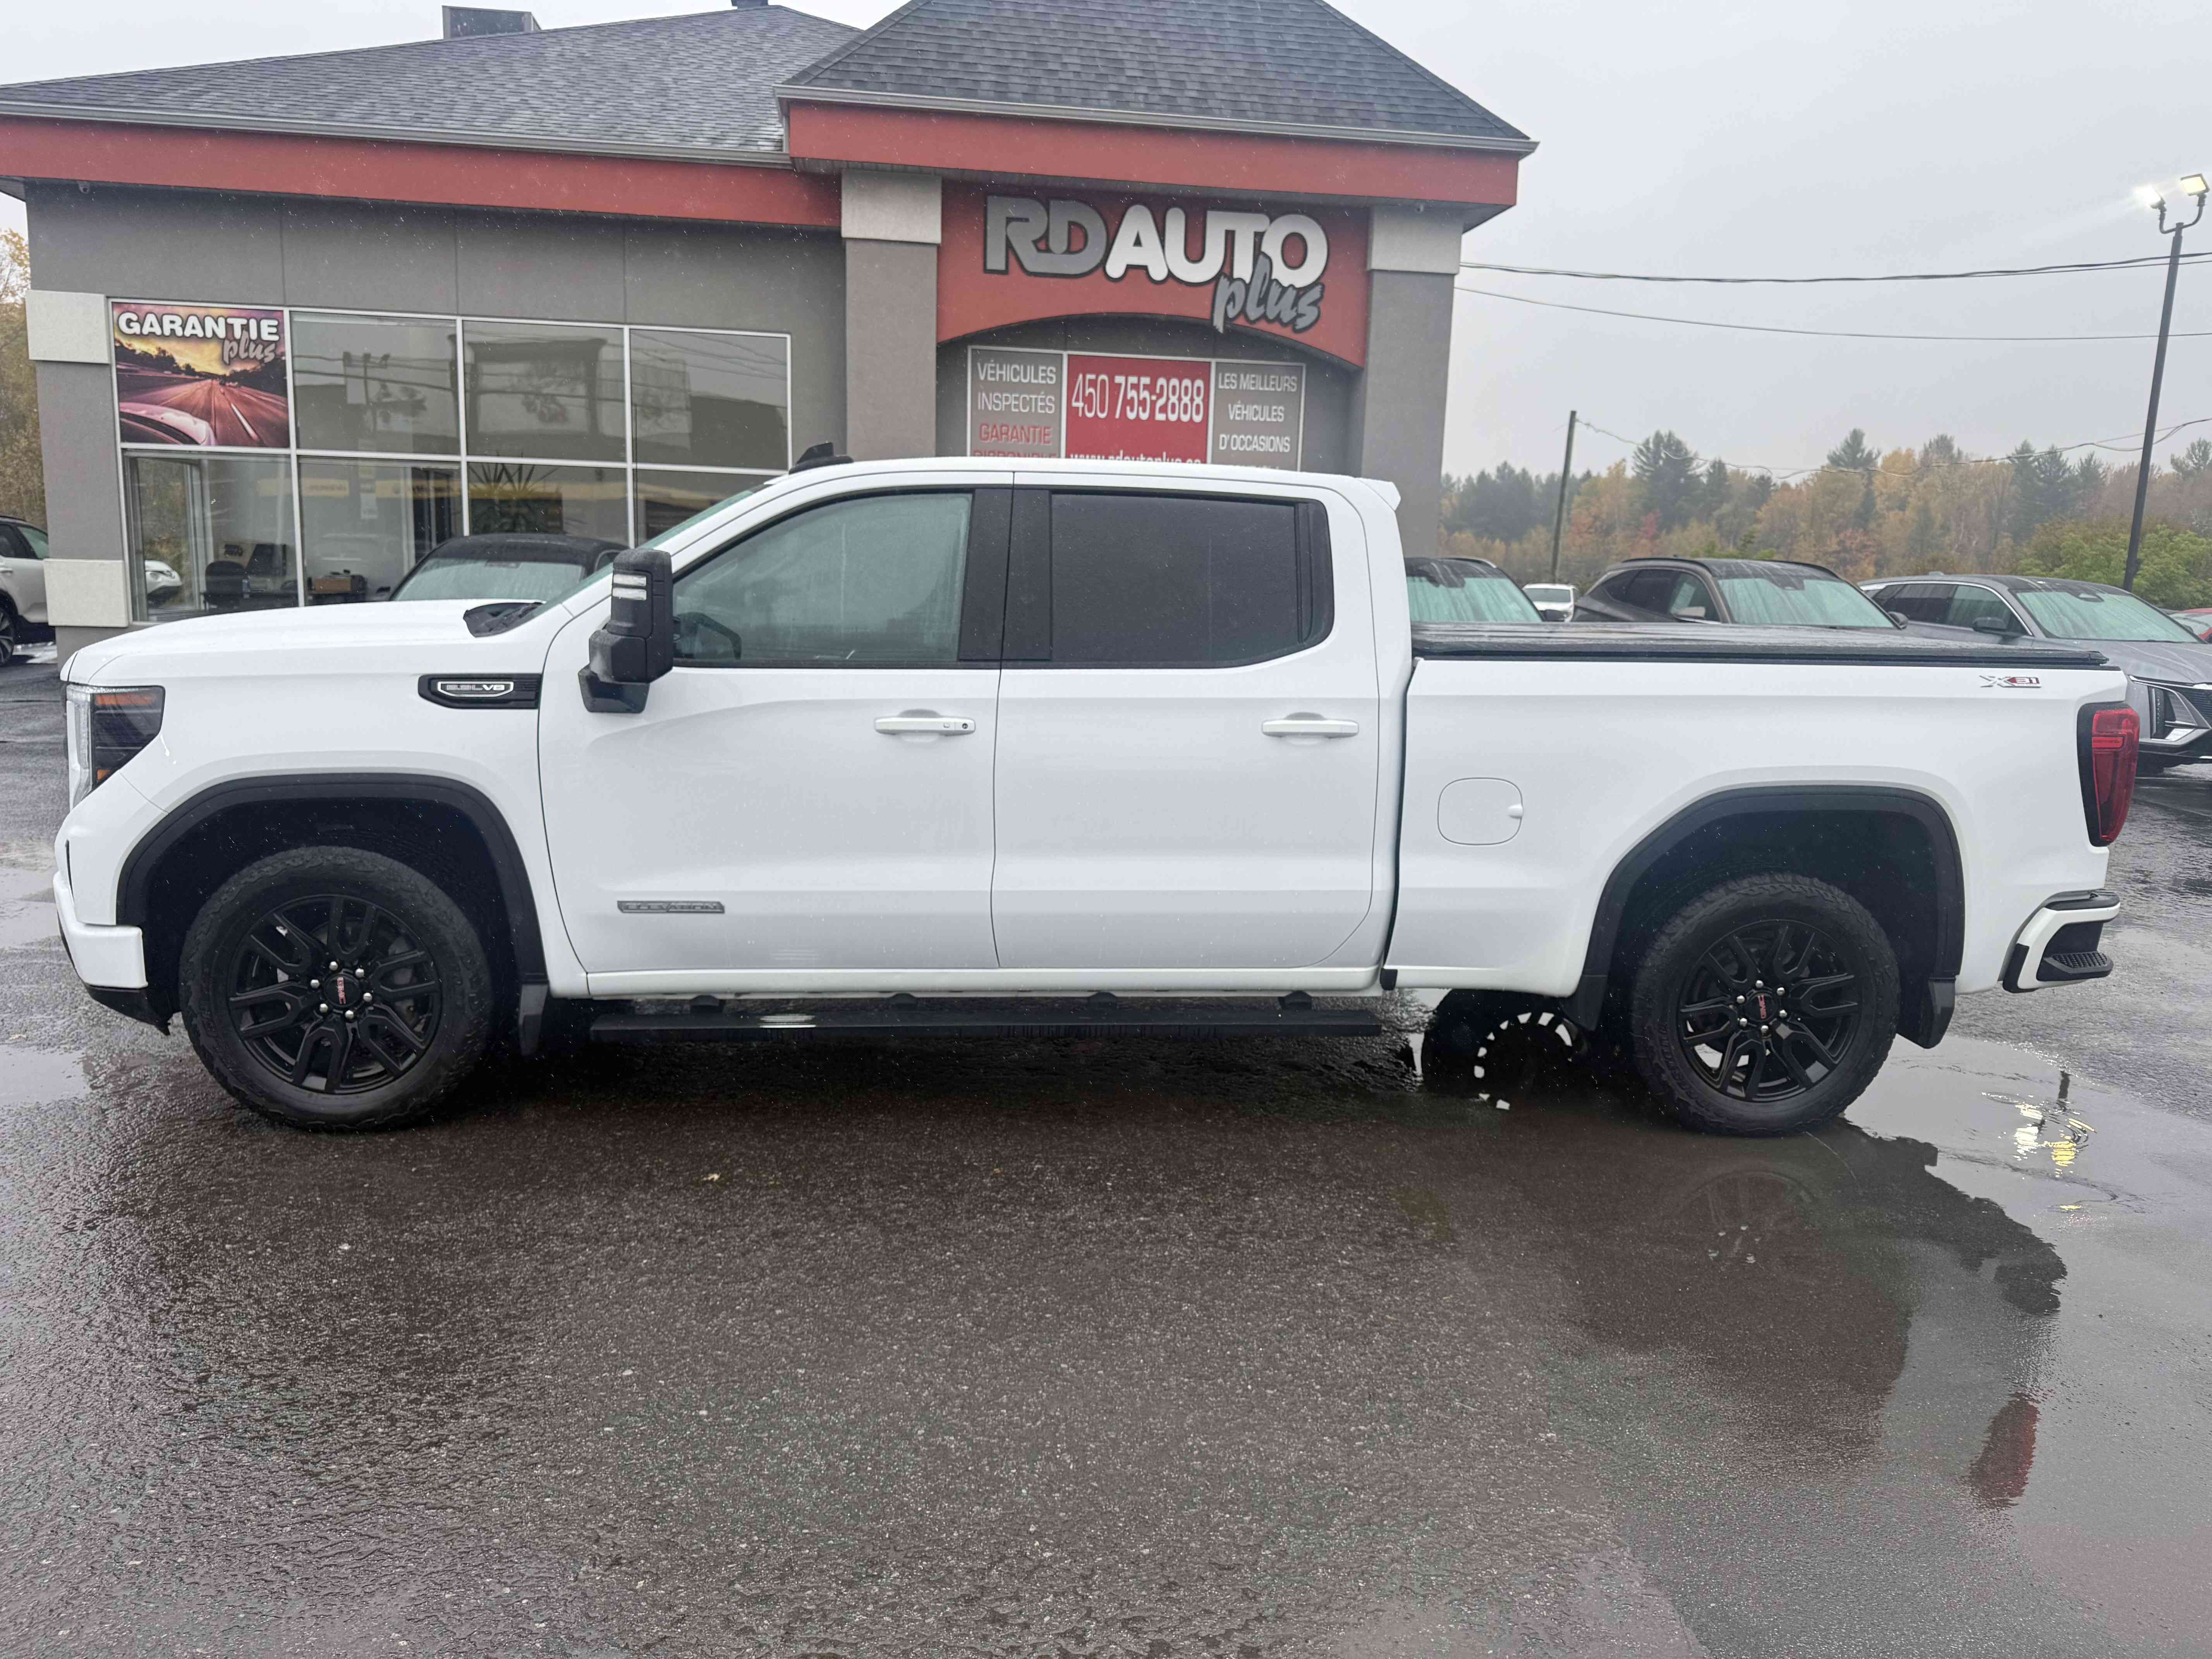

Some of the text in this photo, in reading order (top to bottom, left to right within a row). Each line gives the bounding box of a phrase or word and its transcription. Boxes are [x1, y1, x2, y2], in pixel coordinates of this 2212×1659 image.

[1212, 252, 1324, 334] plus
[118, 312, 280, 341] GARANTIE
[222, 330, 276, 365] plus
[977, 359, 1056, 384] VÉHICULES
[1218, 373, 1298, 392] LES MEILLEURS
[977, 391, 1055, 414] INSPECTÉS
[1072, 373, 1204, 423] 450 755-2888
[1228, 400, 1285, 422] VÉHICULES
[979, 422, 1053, 446] GARANTIE
